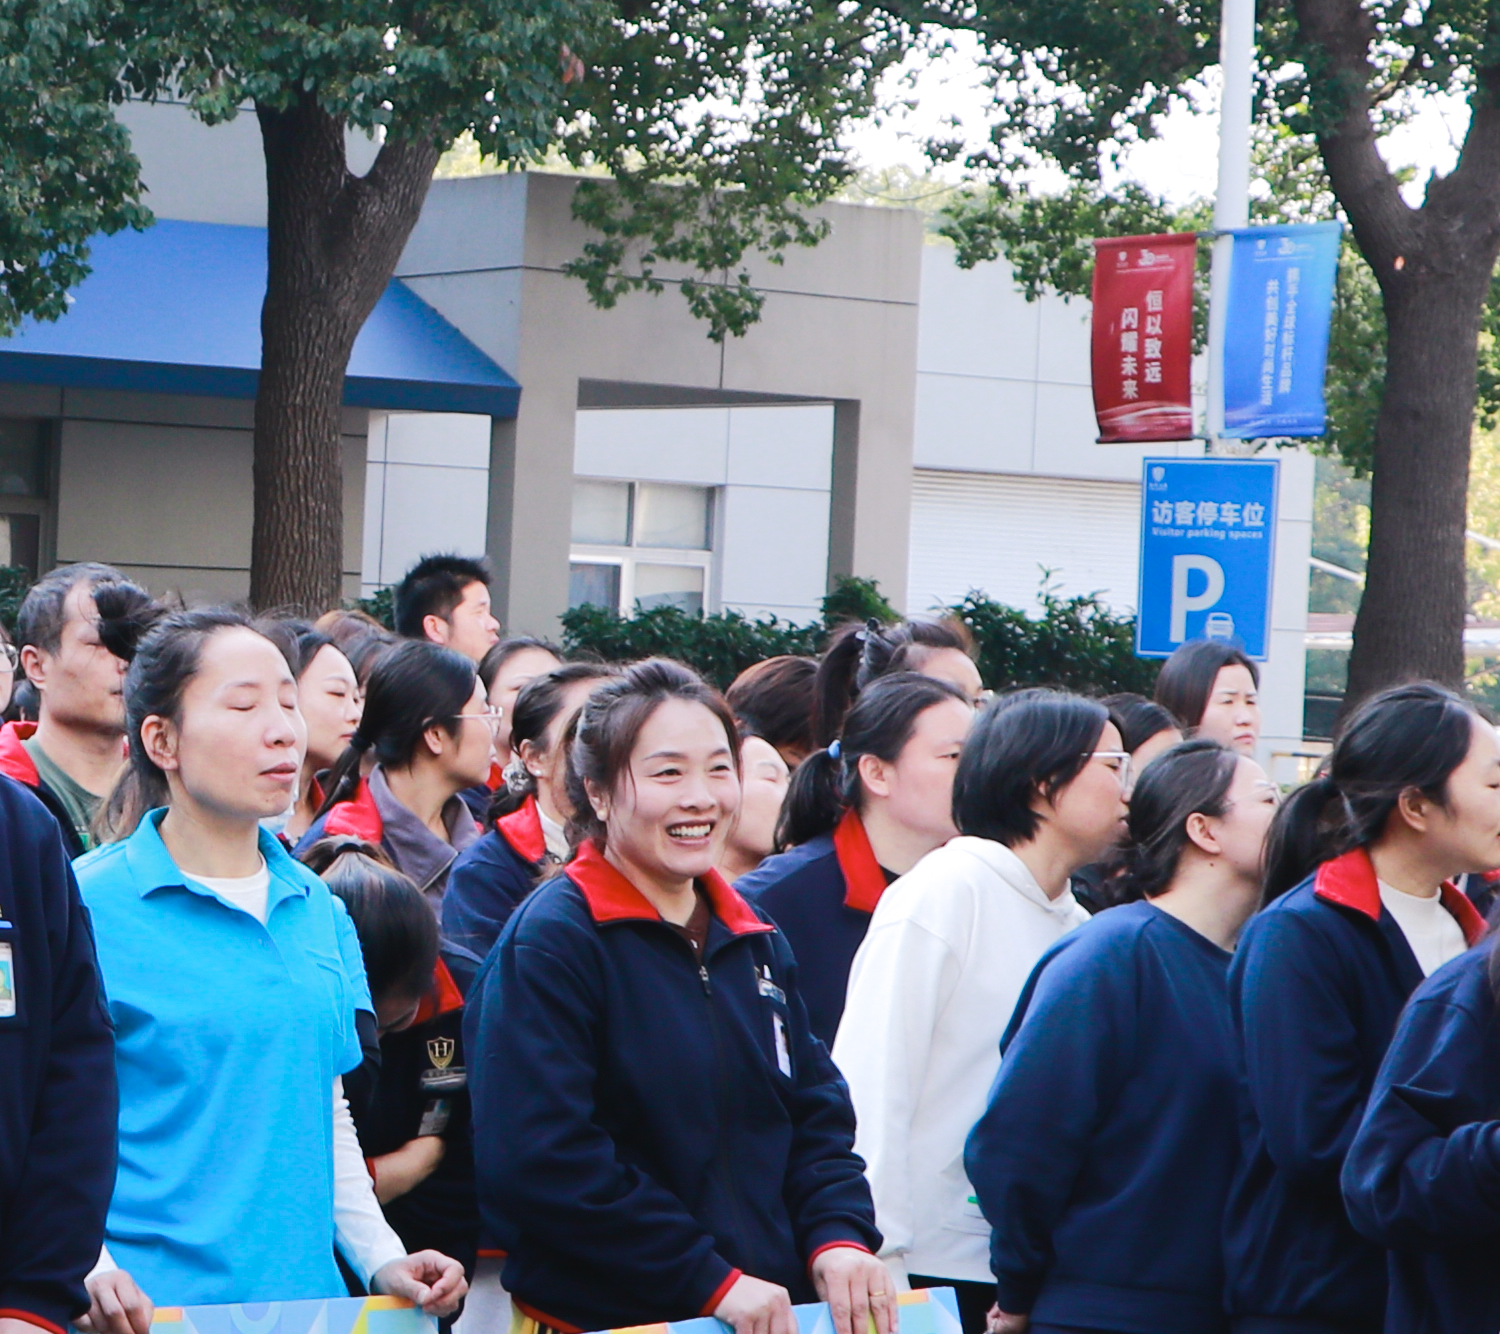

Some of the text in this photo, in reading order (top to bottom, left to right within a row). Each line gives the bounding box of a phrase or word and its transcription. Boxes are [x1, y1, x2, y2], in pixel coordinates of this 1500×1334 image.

[1121, 307, 1139, 399] 闪耀未来
[1145, 290, 1163, 383] 恒以致远
[1152, 500, 1265, 527] 访客停车位
[1152, 527, 1263, 541] Visitor parking spaces
[1170, 553, 1225, 643] P
